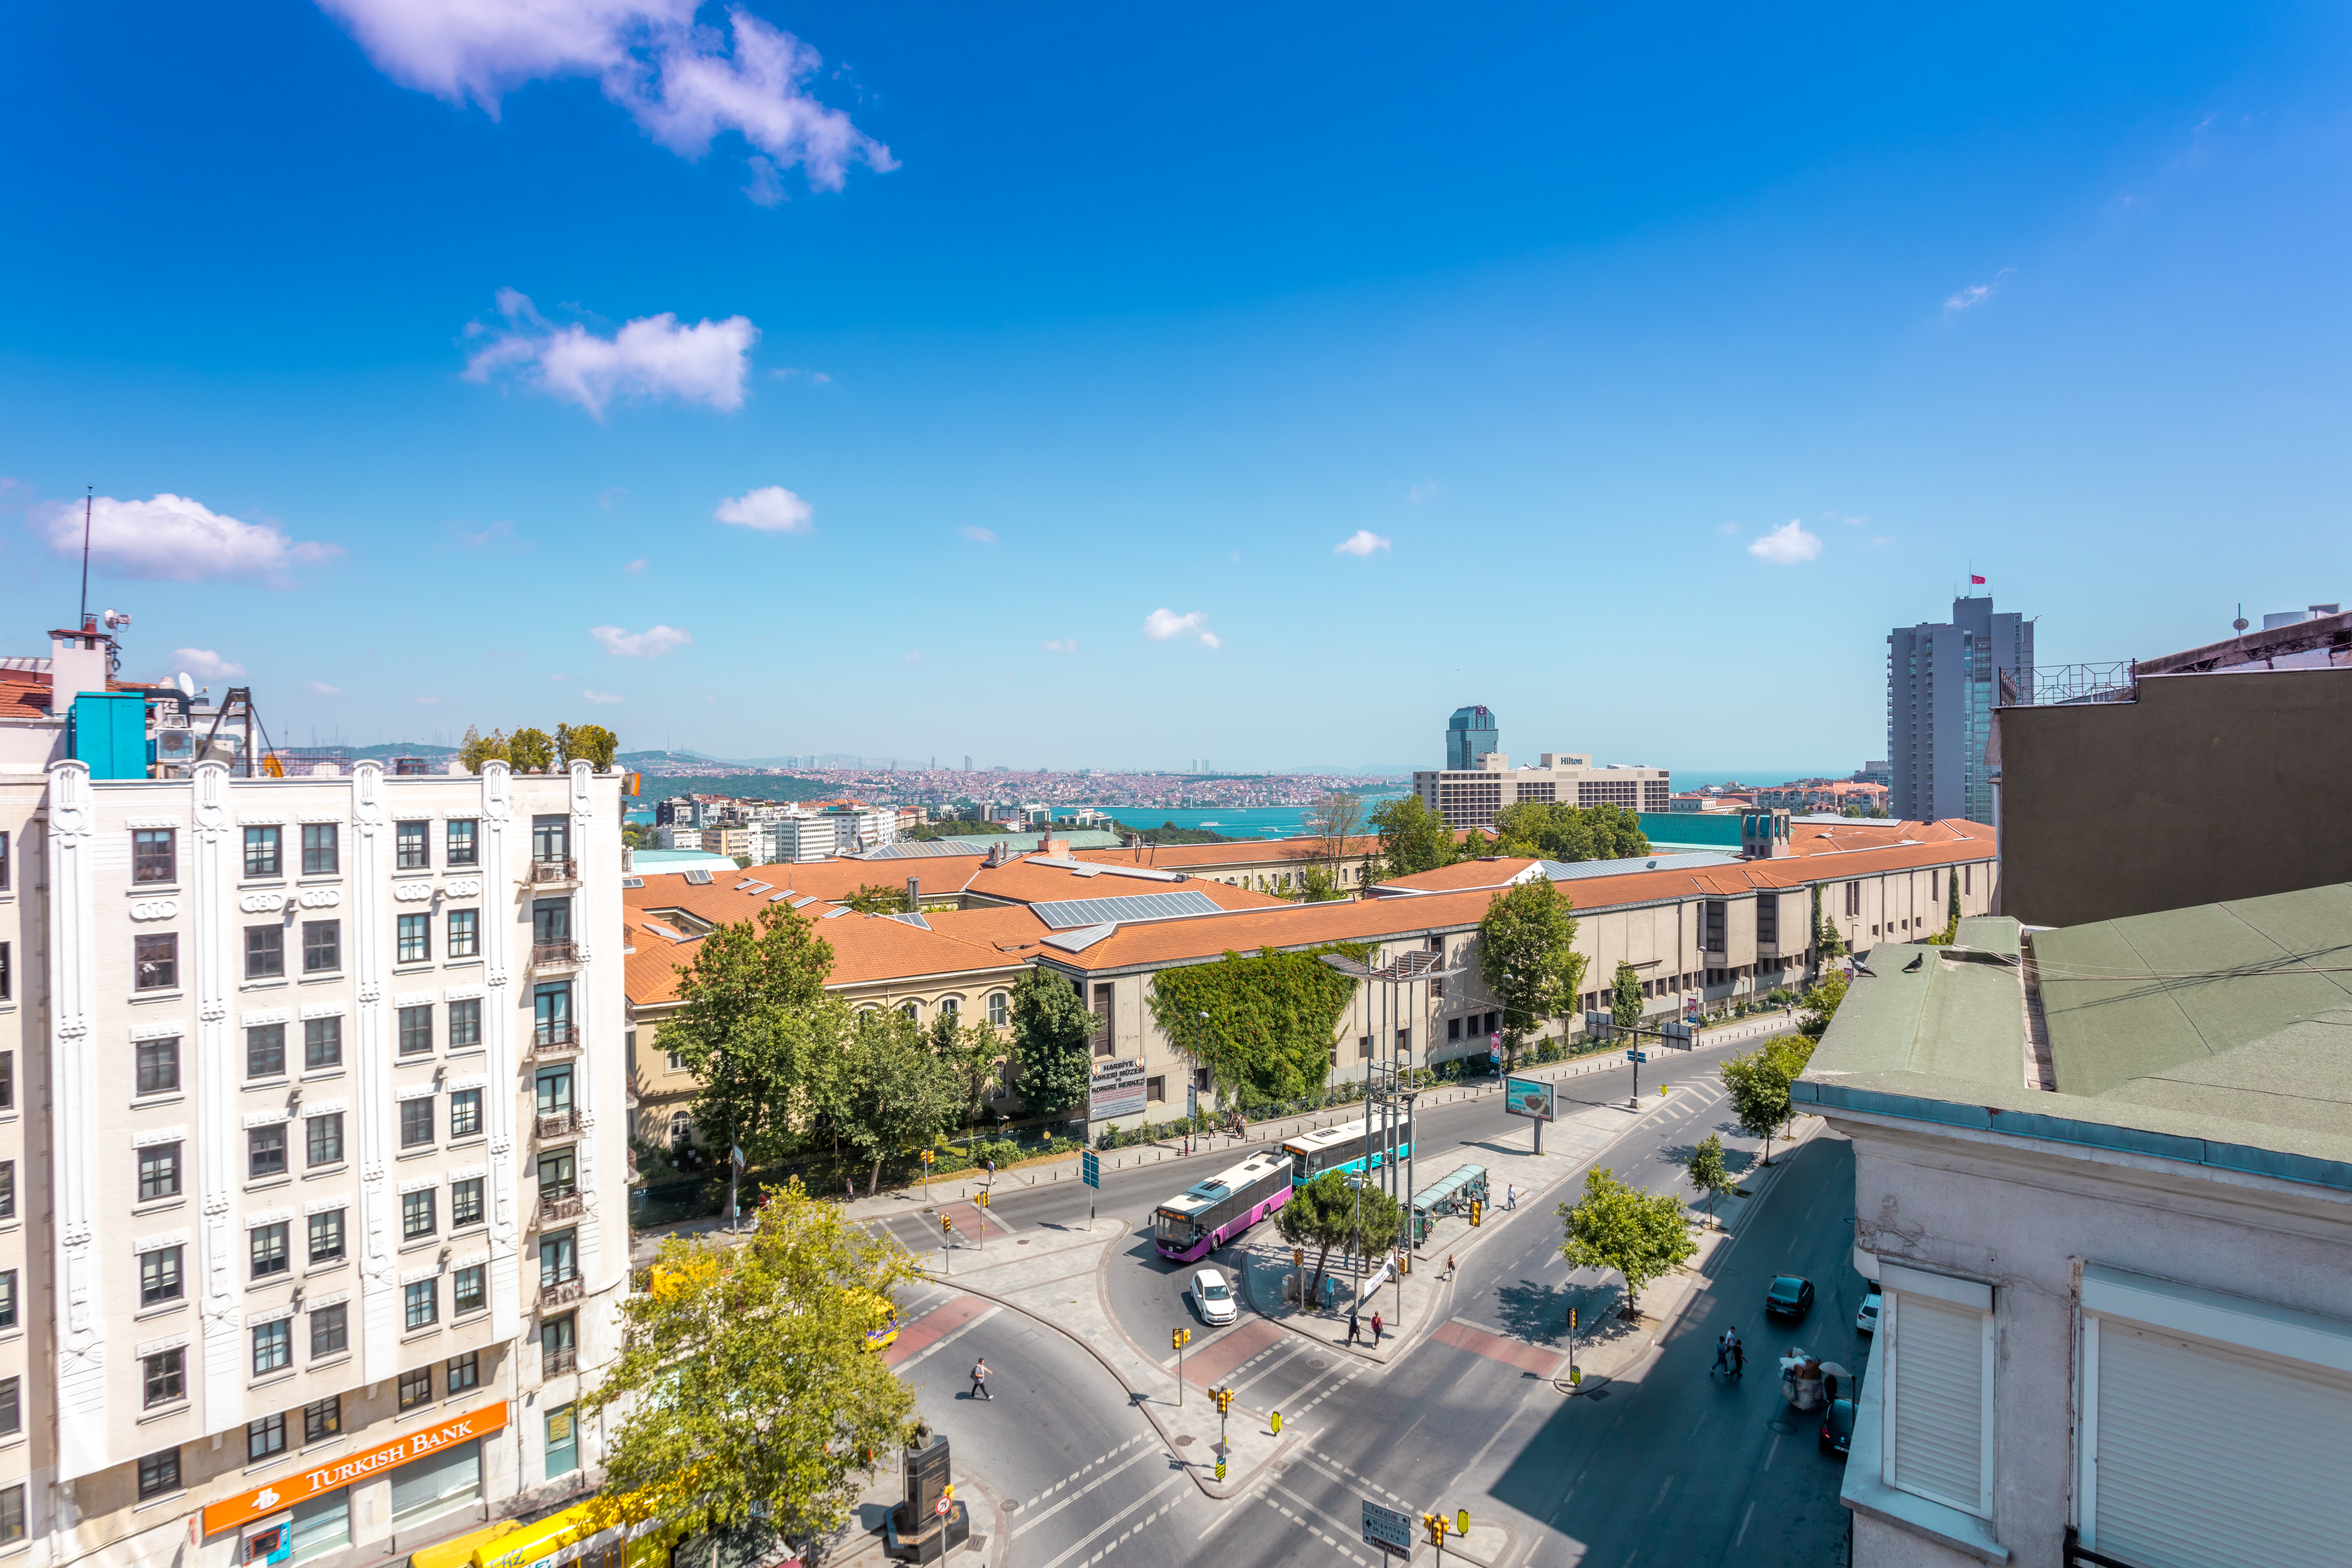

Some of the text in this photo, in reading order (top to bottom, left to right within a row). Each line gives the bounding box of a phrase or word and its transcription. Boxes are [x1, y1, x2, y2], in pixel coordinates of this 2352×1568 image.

[1103, 1060, 1134, 1071] HARBİYE
[1092, 1066, 1145, 1082] ASKERİ MÜZESİ
[1091, 1077, 1145, 1093] KONGRE MERKEZİ
[305, 1420, 472, 1492] TURKISH BANK
[1371, 1506, 1398, 1521] Taksim
[1373, 1519, 1407, 1537] Nişantaşı
[1373, 1526, 1400, 1541] Maçka
[1376, 1540, 1392, 1551] Kongre
